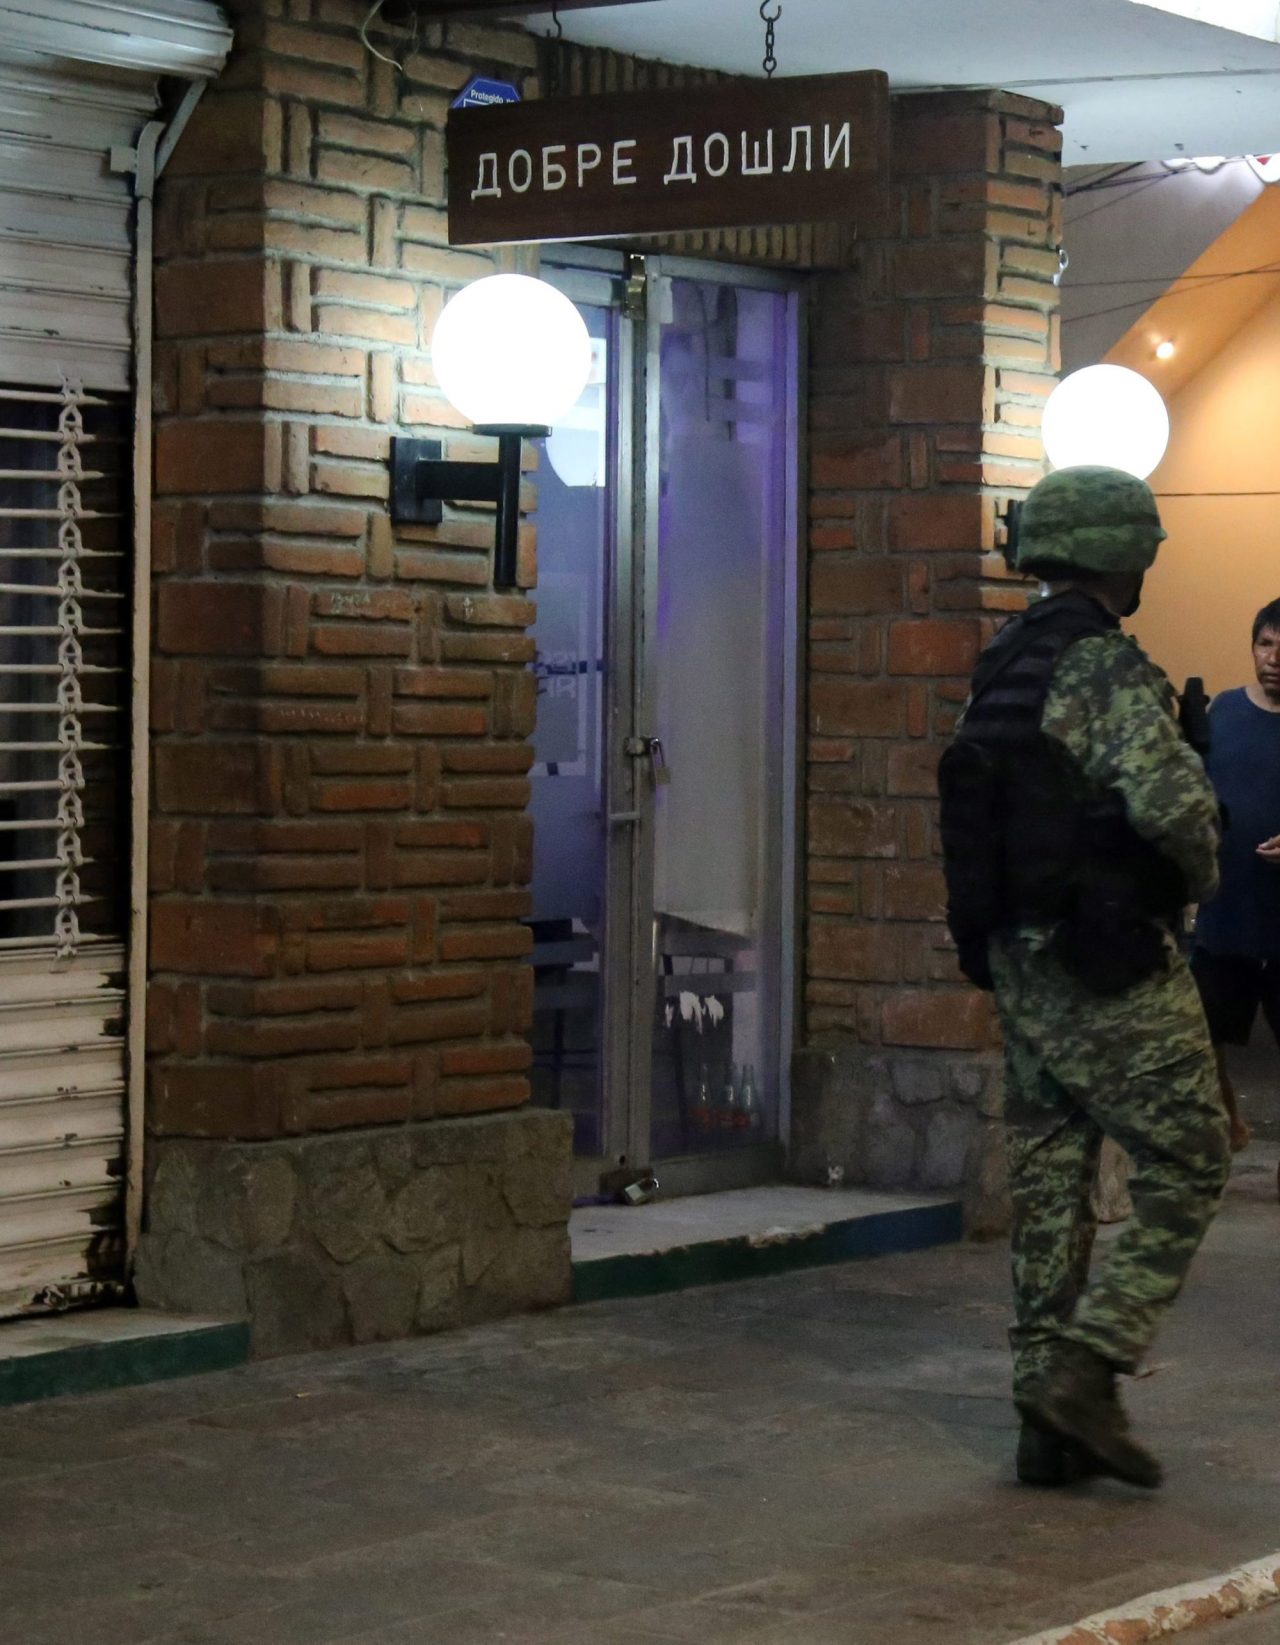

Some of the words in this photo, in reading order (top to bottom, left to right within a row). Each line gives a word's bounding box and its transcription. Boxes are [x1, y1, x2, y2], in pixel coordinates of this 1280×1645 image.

[470, 88, 504, 104] Protegido
[471, 140, 637, 200] ДОБРЕ
[664, 122, 851, 186] ДОШЛИ
